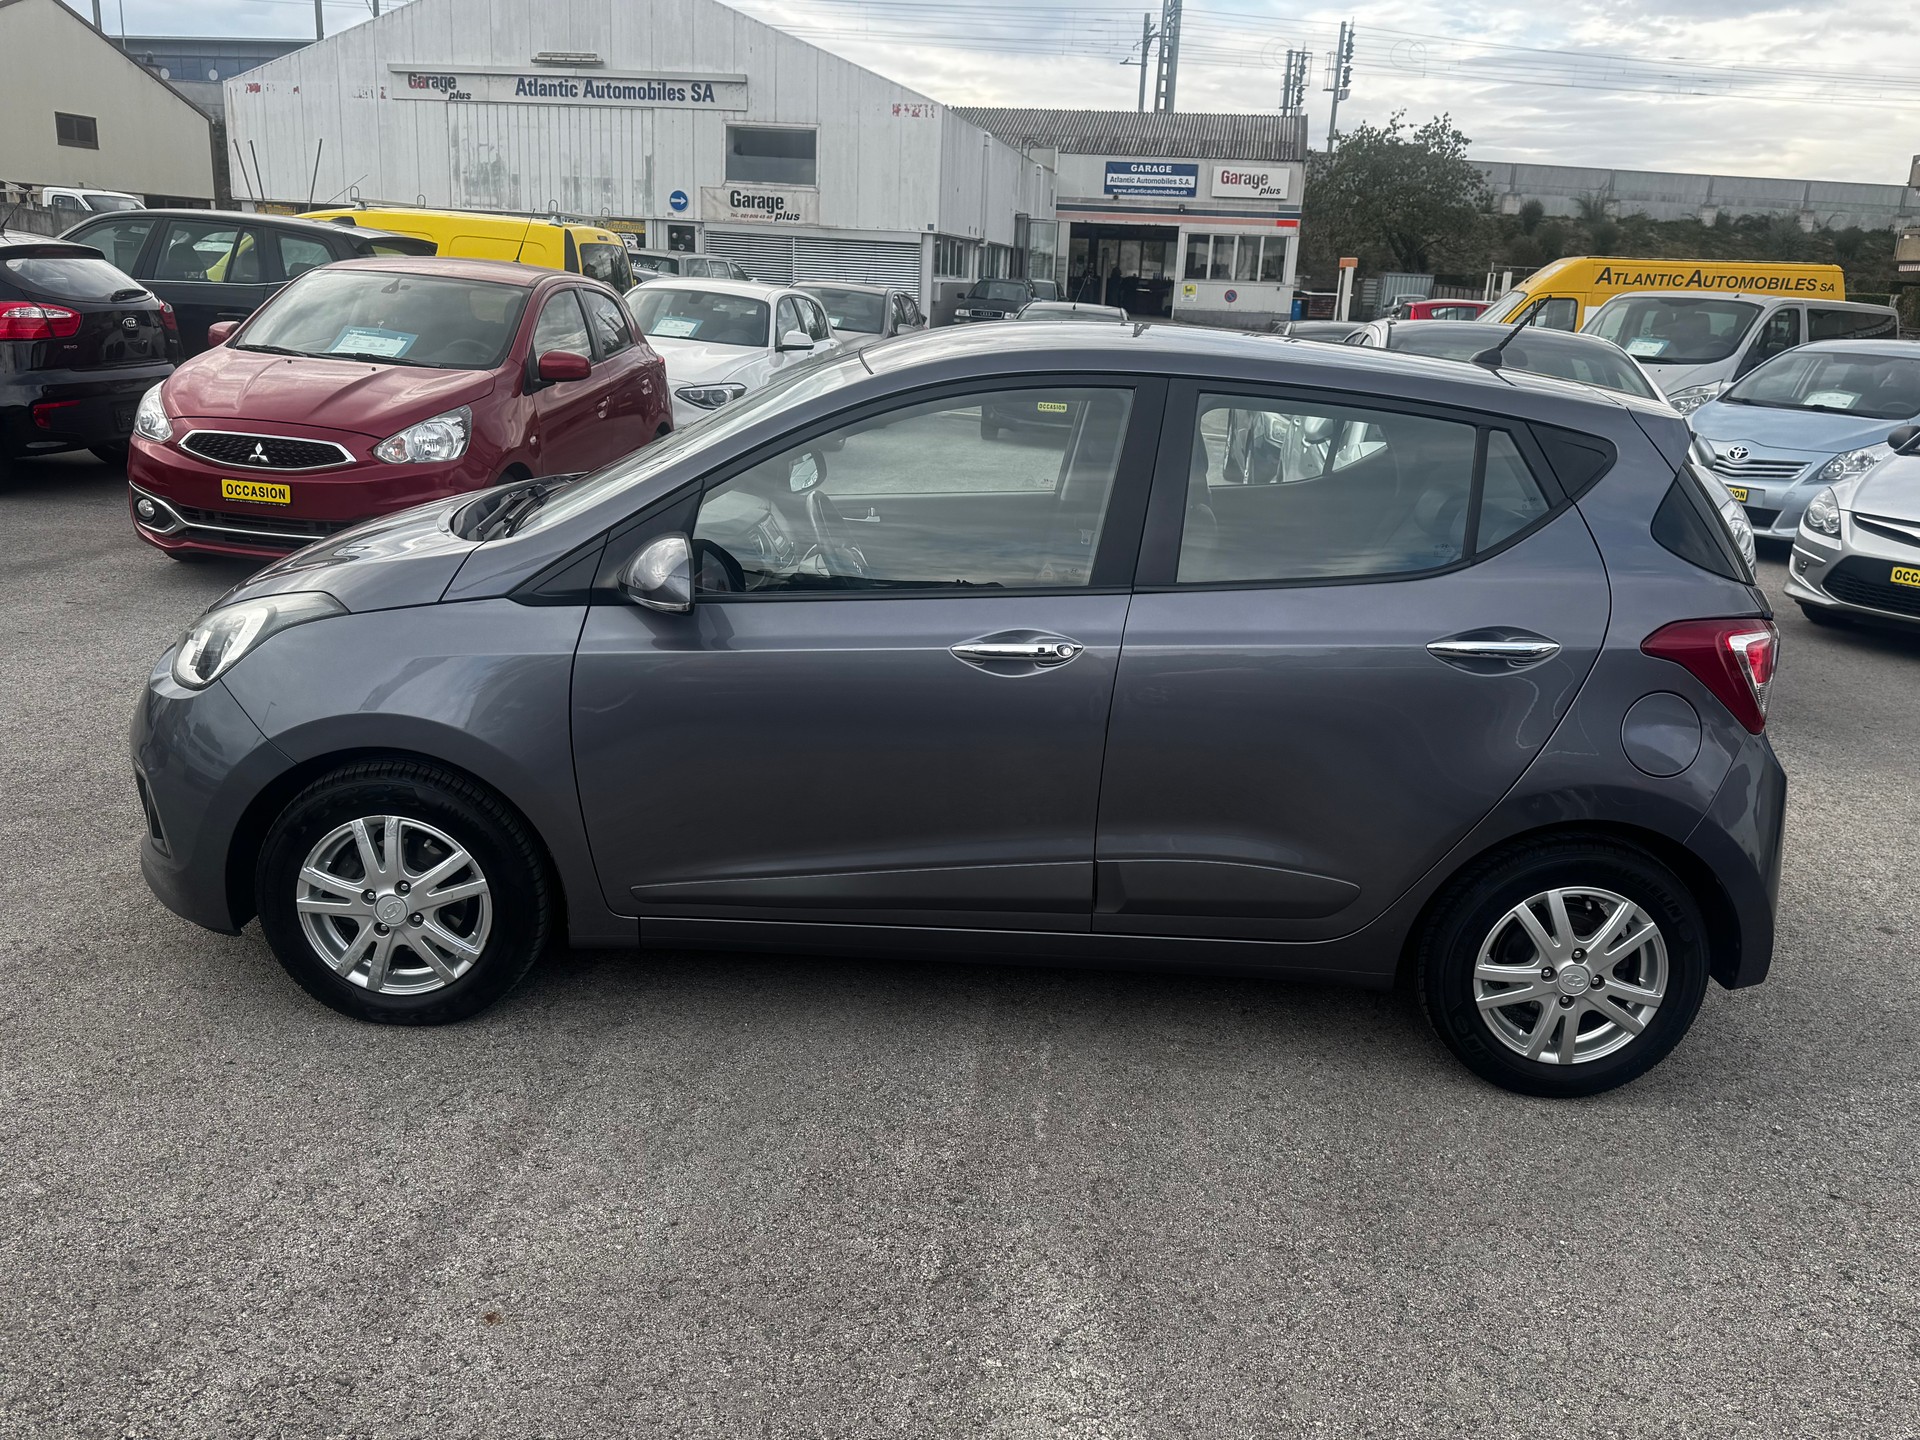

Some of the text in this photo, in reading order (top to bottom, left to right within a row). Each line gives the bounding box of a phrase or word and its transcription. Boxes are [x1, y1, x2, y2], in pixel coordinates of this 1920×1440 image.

[408, 73, 472, 100] Garage plus
[515, 77, 715, 103] Atlantic Automobiles SA
[1130, 164, 1172, 173] GARAGE
[1109, 176, 1192, 186] Atlantic Automobiles S.A.
[1113, 187, 1188, 195] www.atlanticautomobiles.ch
[1221, 170, 1281, 196] Garage plus
[730, 190, 801, 221] Garage plus
[1594, 267, 1835, 292] ATLANTIC AUTOMOBILES SA
[226, 484, 286, 500] OCCASION
[1894, 569, 1920, 584] OCC
